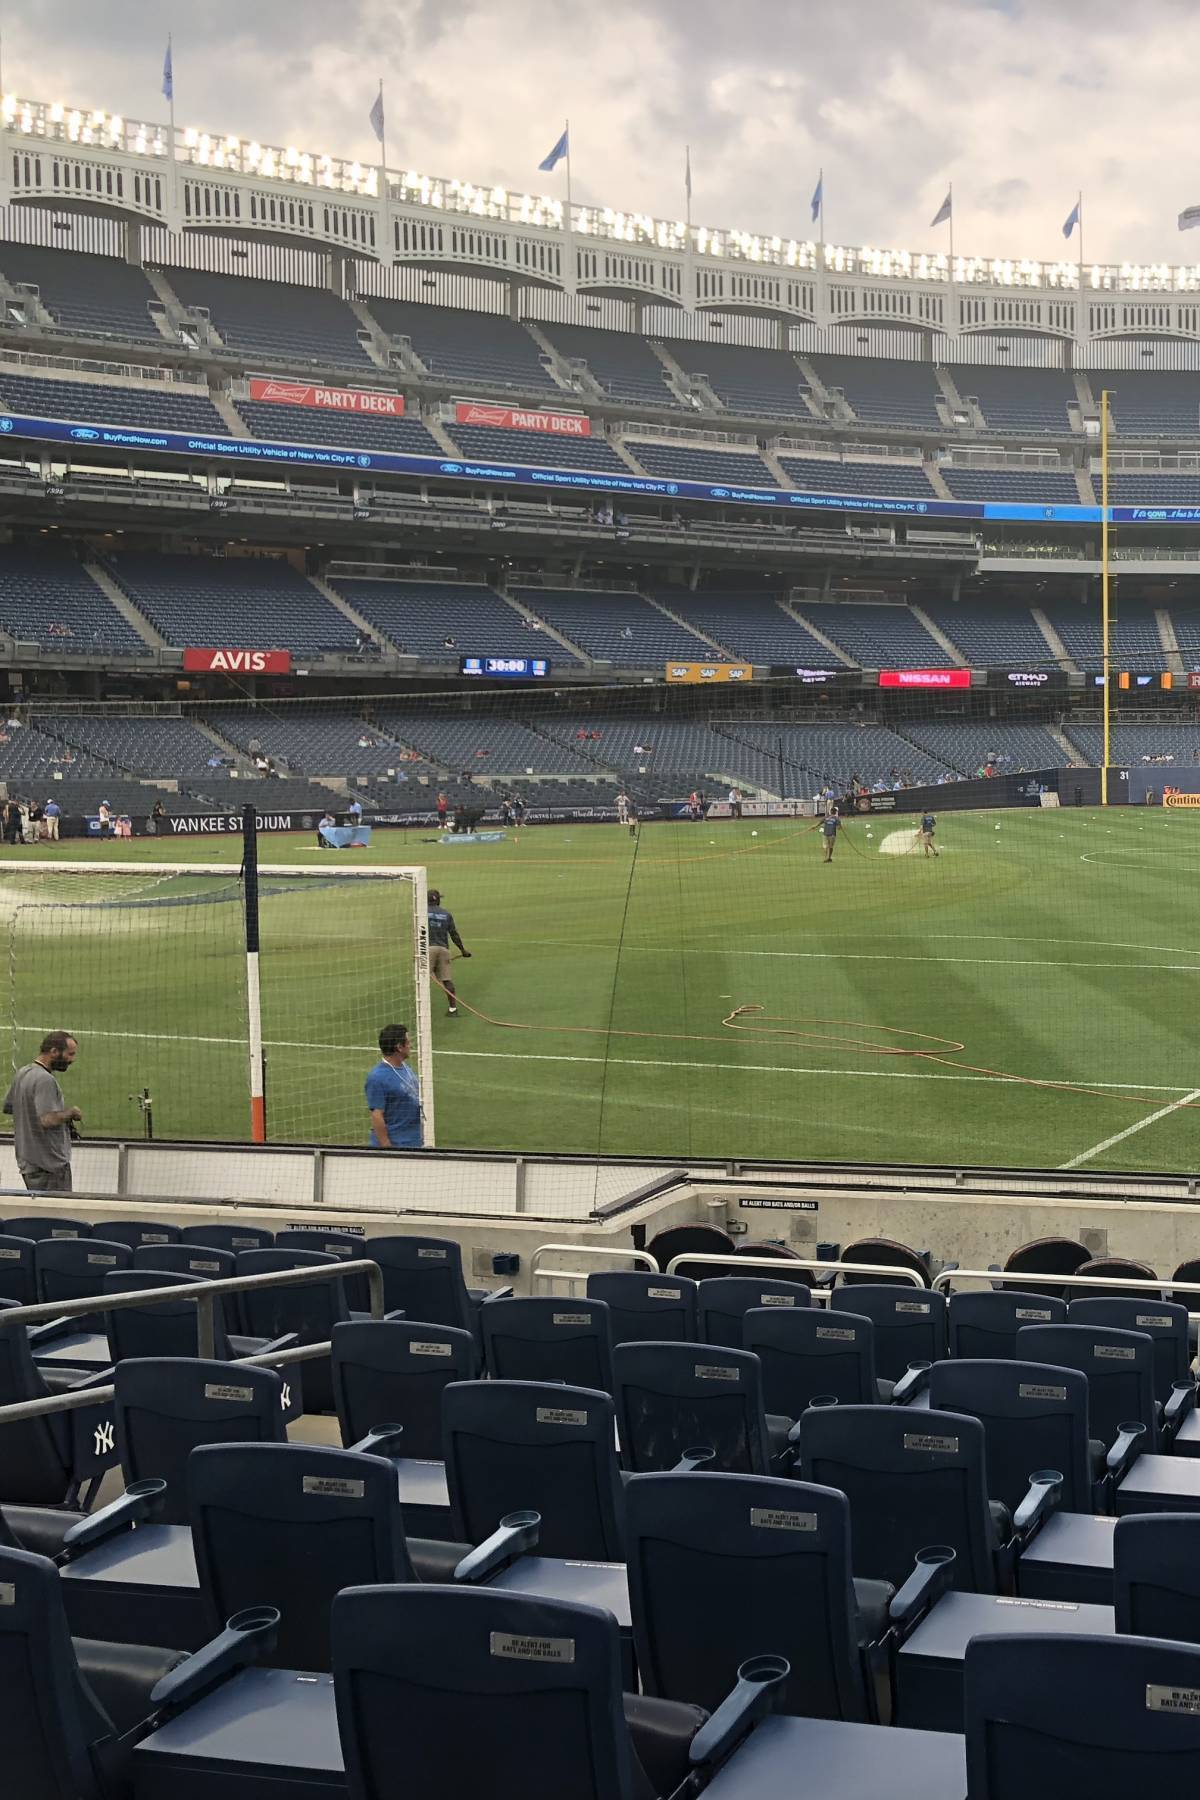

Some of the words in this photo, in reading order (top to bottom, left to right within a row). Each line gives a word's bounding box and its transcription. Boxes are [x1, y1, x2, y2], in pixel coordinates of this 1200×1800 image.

[315, 390, 358, 409] PARTY
[360, 396, 396, 412] DECK
[511, 412, 549, 429] PARTY
[551, 417, 582, 433] DECK
[103, 432, 168, 446] BuyFordNow.com
[188, 440, 216, 451] Official
[217, 443, 238, 454] Sport
[239, 445, 261, 457] Utility
[262, 447, 288, 457] Vehicle
[289, 450, 298, 458] of
[298, 452, 314, 460] New
[315, 453, 331, 462] York
[331, 455, 345, 464] City
[346, 456, 356, 464] FC
[531, 472, 554, 481] Official
[555, 474, 571, 483] Sport
[591, 478, 611, 486] Vehicle
[645, 483, 657, 491] City
[209, 651, 267, 671] AVIS
[671, 668, 687, 677] SAP
[700, 668, 715, 678] SAP
[728, 668, 744, 679] SAP
[899, 674, 950, 683] NISSAN
[1007, 673, 1048, 682] ETIHAD
[169, 816, 225, 833] YANKEE
[1160, 1699, 1178, 1708] BATS
